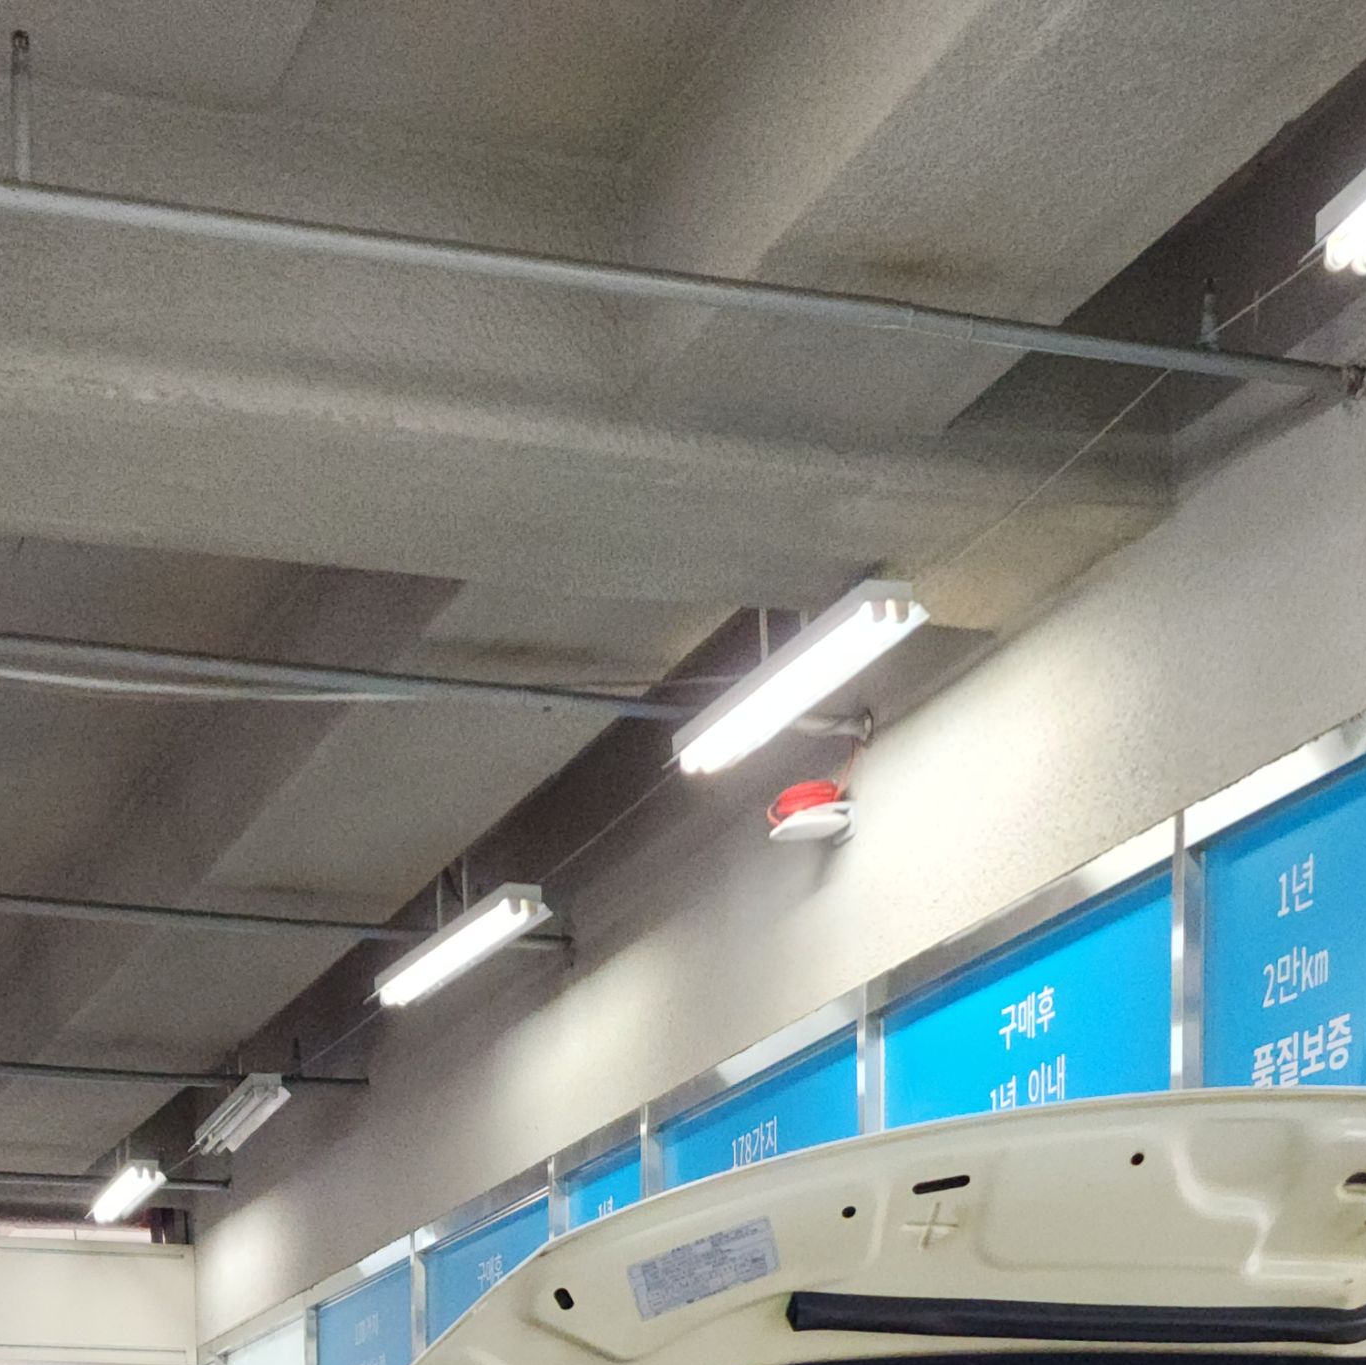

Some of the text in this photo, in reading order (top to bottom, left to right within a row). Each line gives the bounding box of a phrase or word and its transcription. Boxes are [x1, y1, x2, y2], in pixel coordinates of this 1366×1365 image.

[1277, 853, 1315, 917] 1년
[1262, 946, 1330, 1009] 2만km
[998, 985, 1056, 1050] 구매후
[1027, 1053, 1066, 1105] 이내
[1251, 1013, 1352, 1087] 품질보증
[731, 1116, 778, 1169] 178가지
